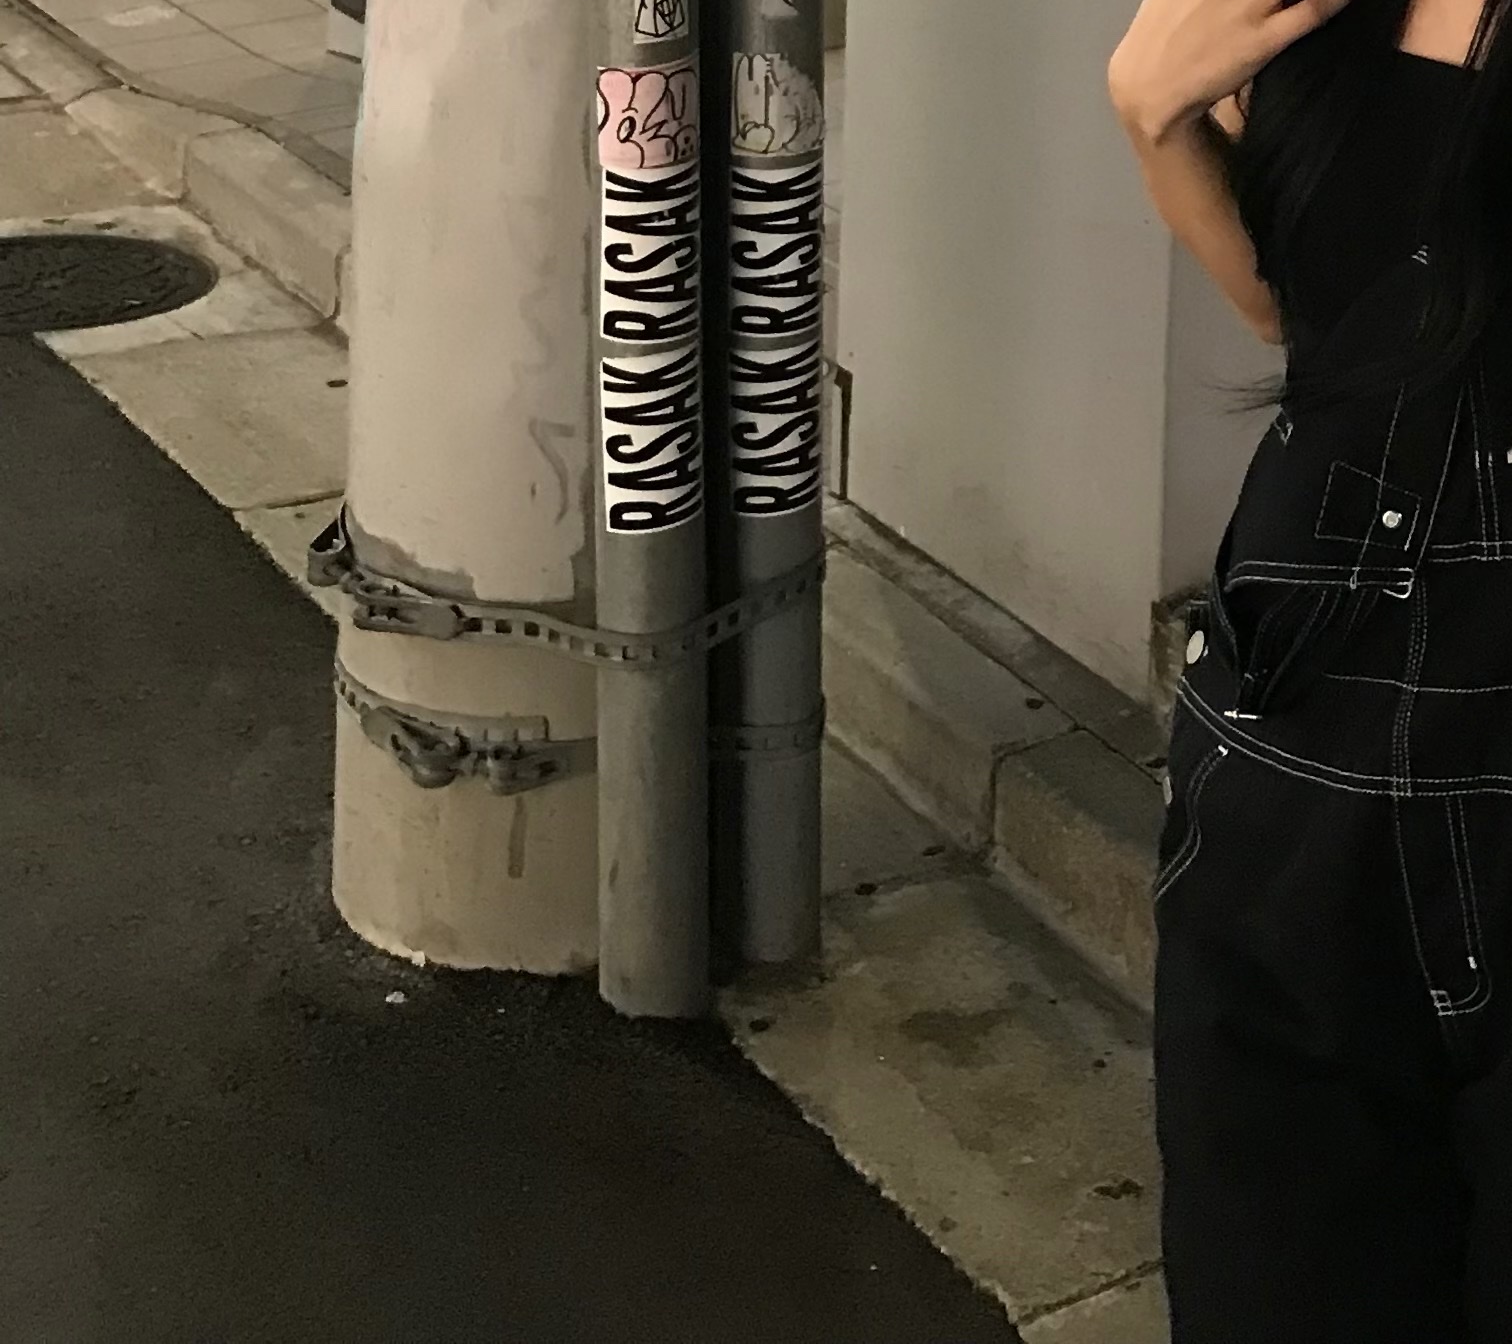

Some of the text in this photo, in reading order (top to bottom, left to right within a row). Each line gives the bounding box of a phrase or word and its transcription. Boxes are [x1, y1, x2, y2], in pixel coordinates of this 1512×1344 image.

[603, 164, 699, 341] RASAK
[731, 163, 821, 335] RASAK
[602, 349, 702, 531] RASAK
[731, 340, 821, 514] RASAK
